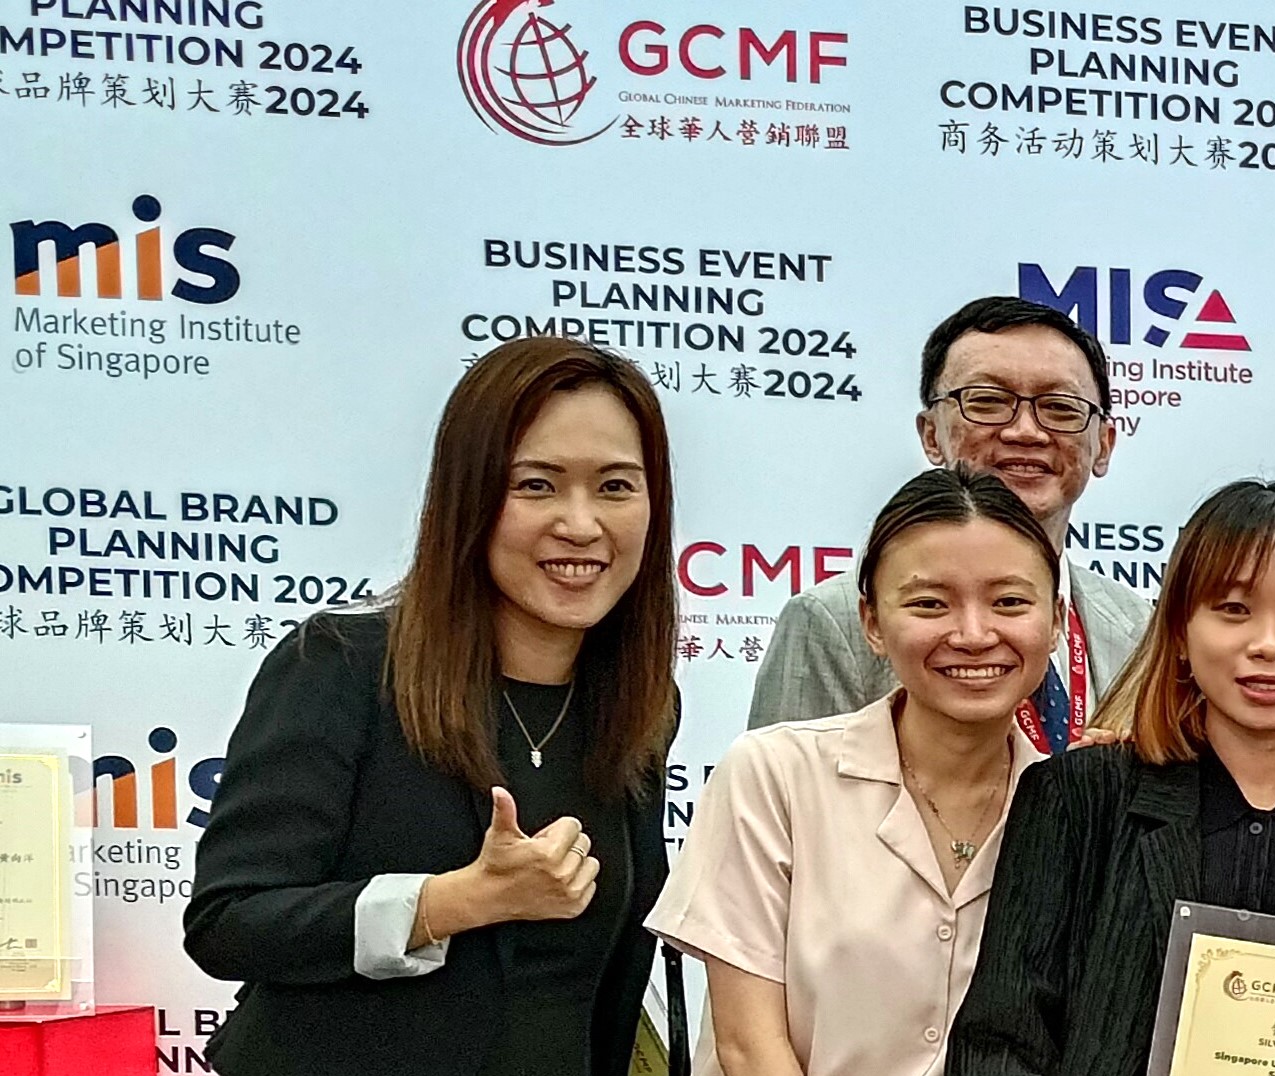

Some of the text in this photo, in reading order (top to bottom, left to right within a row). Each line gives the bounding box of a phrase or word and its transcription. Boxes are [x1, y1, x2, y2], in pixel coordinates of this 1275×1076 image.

[965, 6, 1162, 45] BUSINESS
[0, 26, 362, 74] MPETITION 2024
[619, 20, 848, 84] GCMF
[1031, 48, 1238, 87] PLANNING
[0, 71, 370, 119] 品牌策划大赛2024
[715, 96, 781, 109] MARKETING
[786, 100, 850, 113] FEDERATION
[941, 80, 1219, 124] COMPETITION
[9, 195, 240, 304] mis
[484, 239, 832, 282] BUSINESS EVENT
[553, 280, 763, 316] PLANNING
[15, 307, 300, 344] Marketing Institute
[461, 313, 856, 359] COMPETITION 2024
[16, 342, 209, 379] of Singapore
[1153, 359, 1252, 383] Institute
[1110, 388, 1182, 408] apore
[181, 493, 338, 525] BRAND
[49, 527, 278, 563] PLANNING
[677, 541, 853, 598] CMF
[274, 577, 374, 606] 2024
[1020, 709, 1040, 741] GCMF
[1214, 1051, 1268, 1067] Singapore
